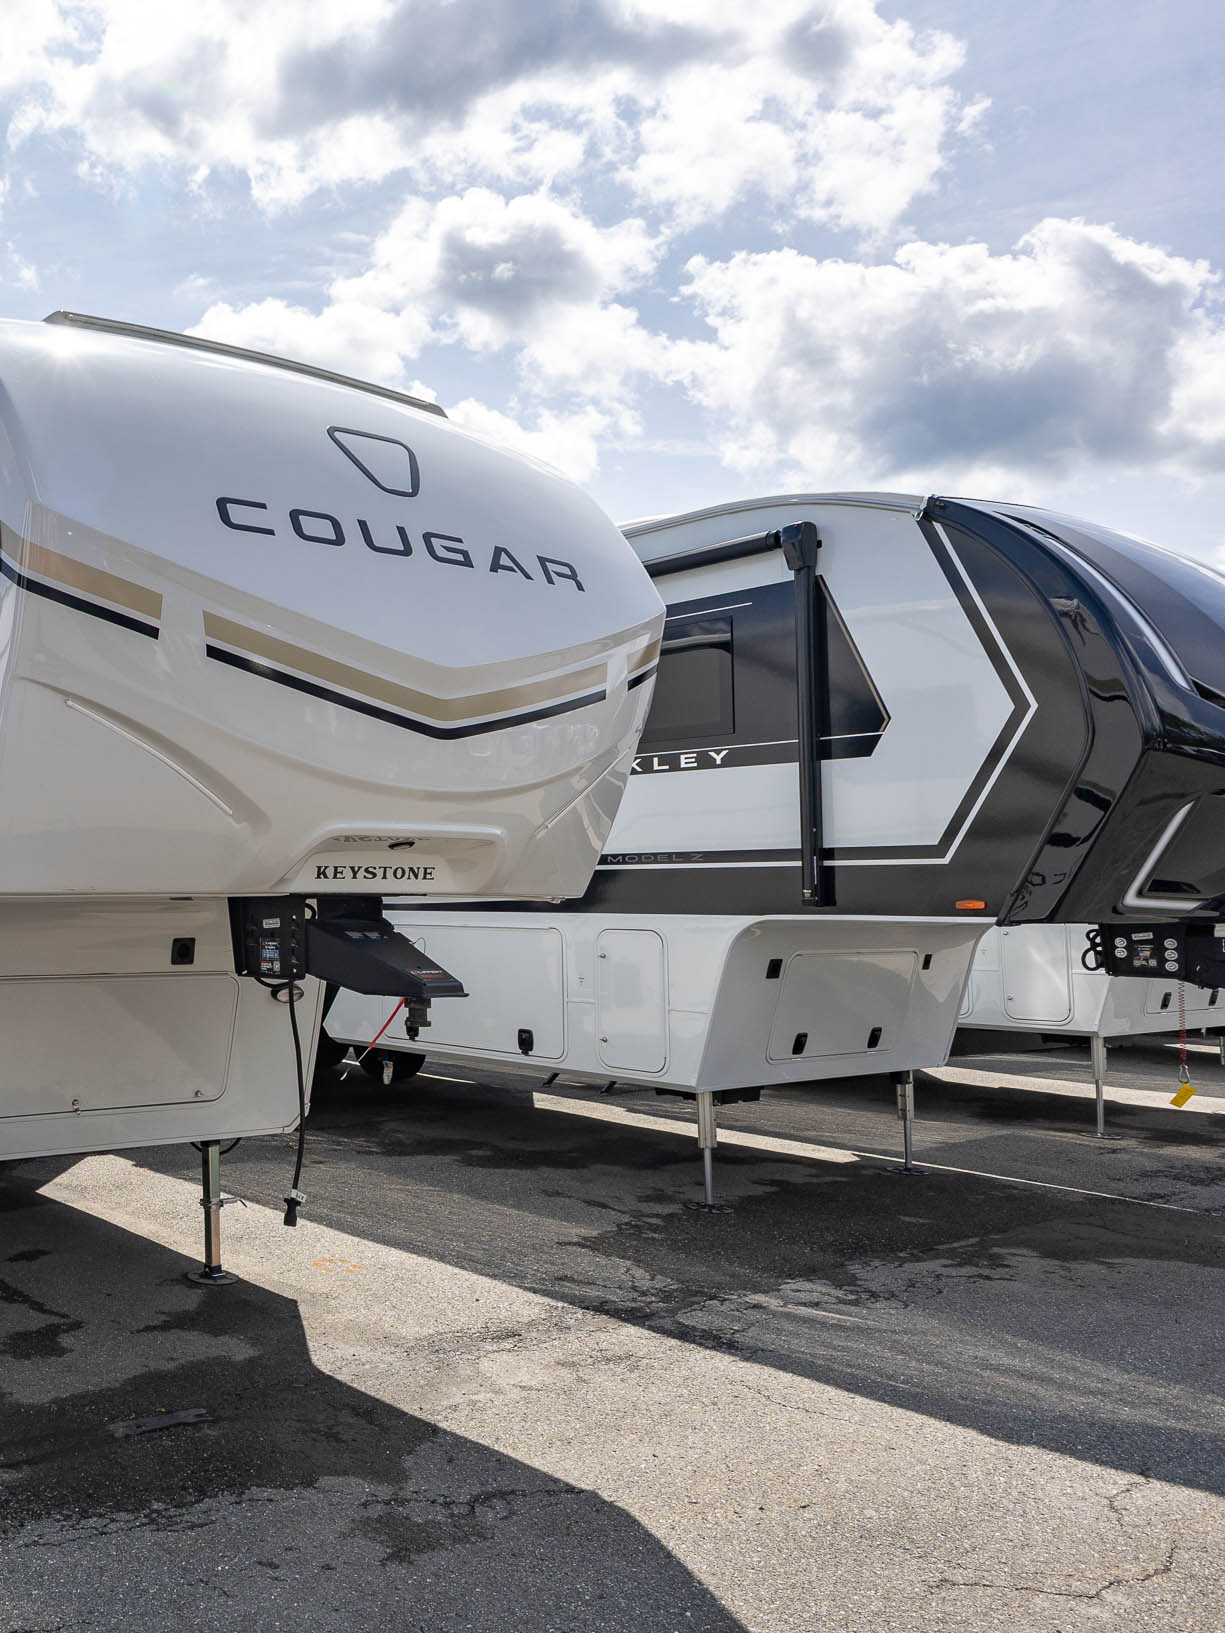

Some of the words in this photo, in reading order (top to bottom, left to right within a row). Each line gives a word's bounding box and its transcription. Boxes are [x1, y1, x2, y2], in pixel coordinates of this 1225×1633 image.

[216, 497, 586, 592] COUGAR
[607, 854, 683, 863] MODEL
[690, 853, 705, 861] Z
[315, 865, 436, 880] KEYSTONE
